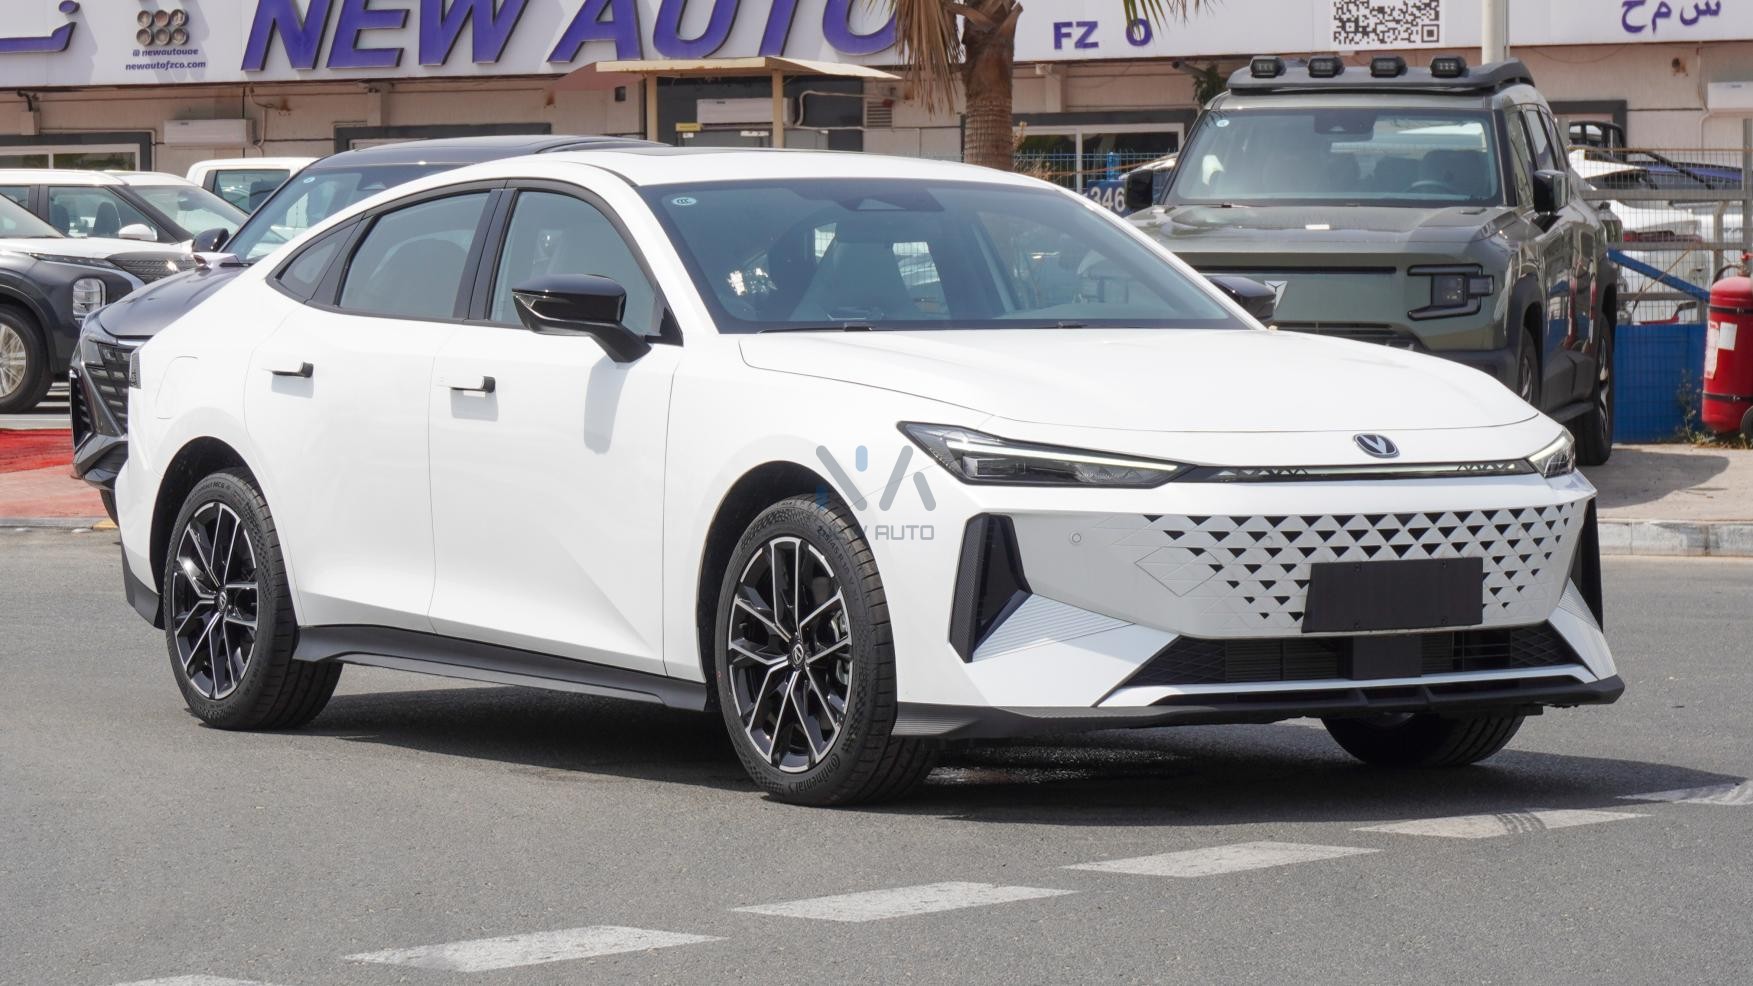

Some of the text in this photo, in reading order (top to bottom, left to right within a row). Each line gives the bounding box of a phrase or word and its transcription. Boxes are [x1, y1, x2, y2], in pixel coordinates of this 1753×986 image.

[241, 0, 527, 71] NEW
[142, 48, 199, 57] newautouae
[125, 60, 206, 71] newautofzco.com
